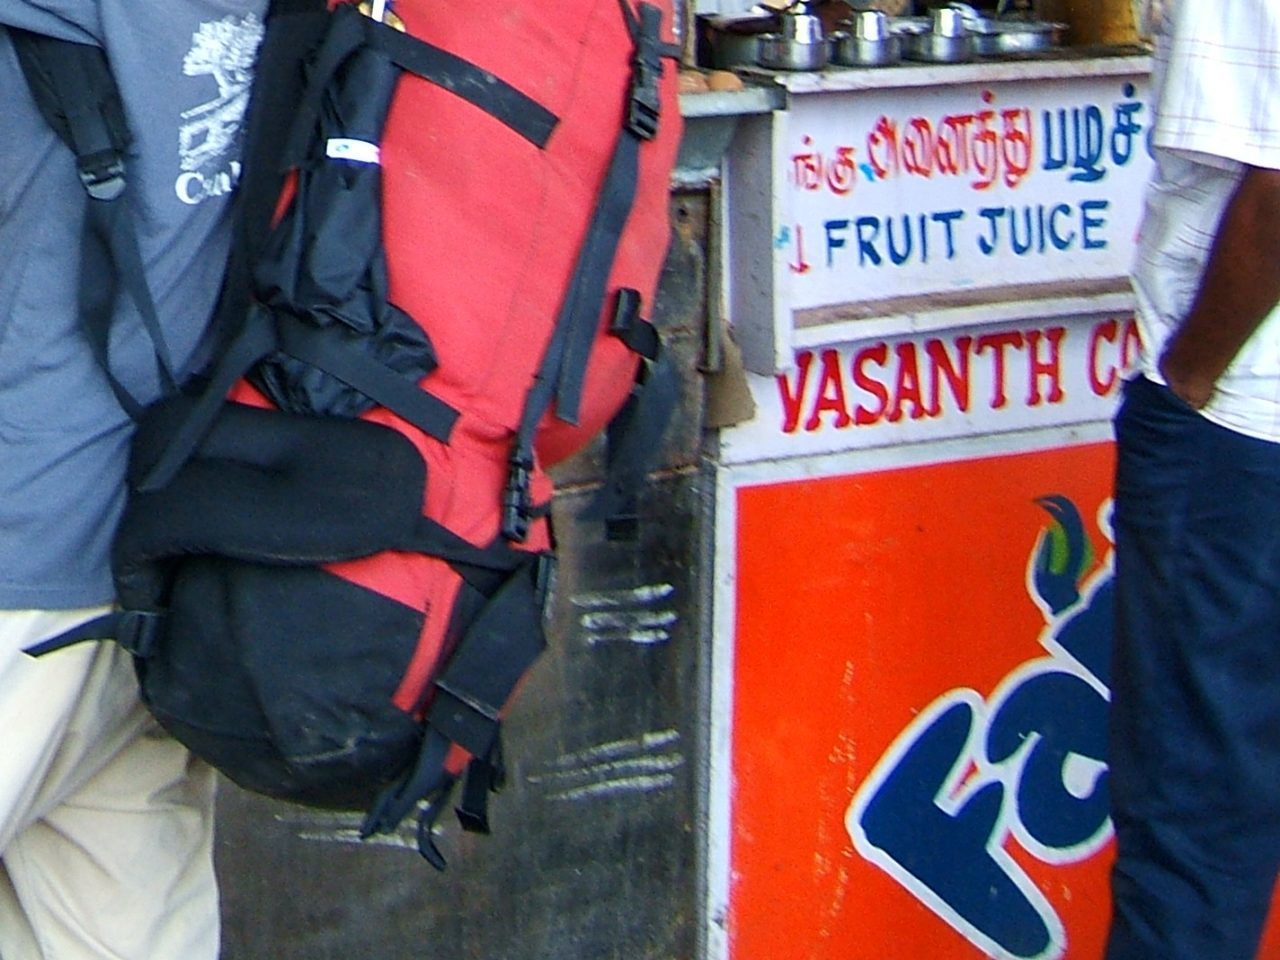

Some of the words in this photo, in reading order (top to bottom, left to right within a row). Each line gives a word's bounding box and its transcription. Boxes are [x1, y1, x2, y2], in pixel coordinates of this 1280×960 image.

[825, 209, 965, 268] FRUIT
[978, 199, 1110, 257] JUICE
[776, 326, 1067, 434] VASANTH
